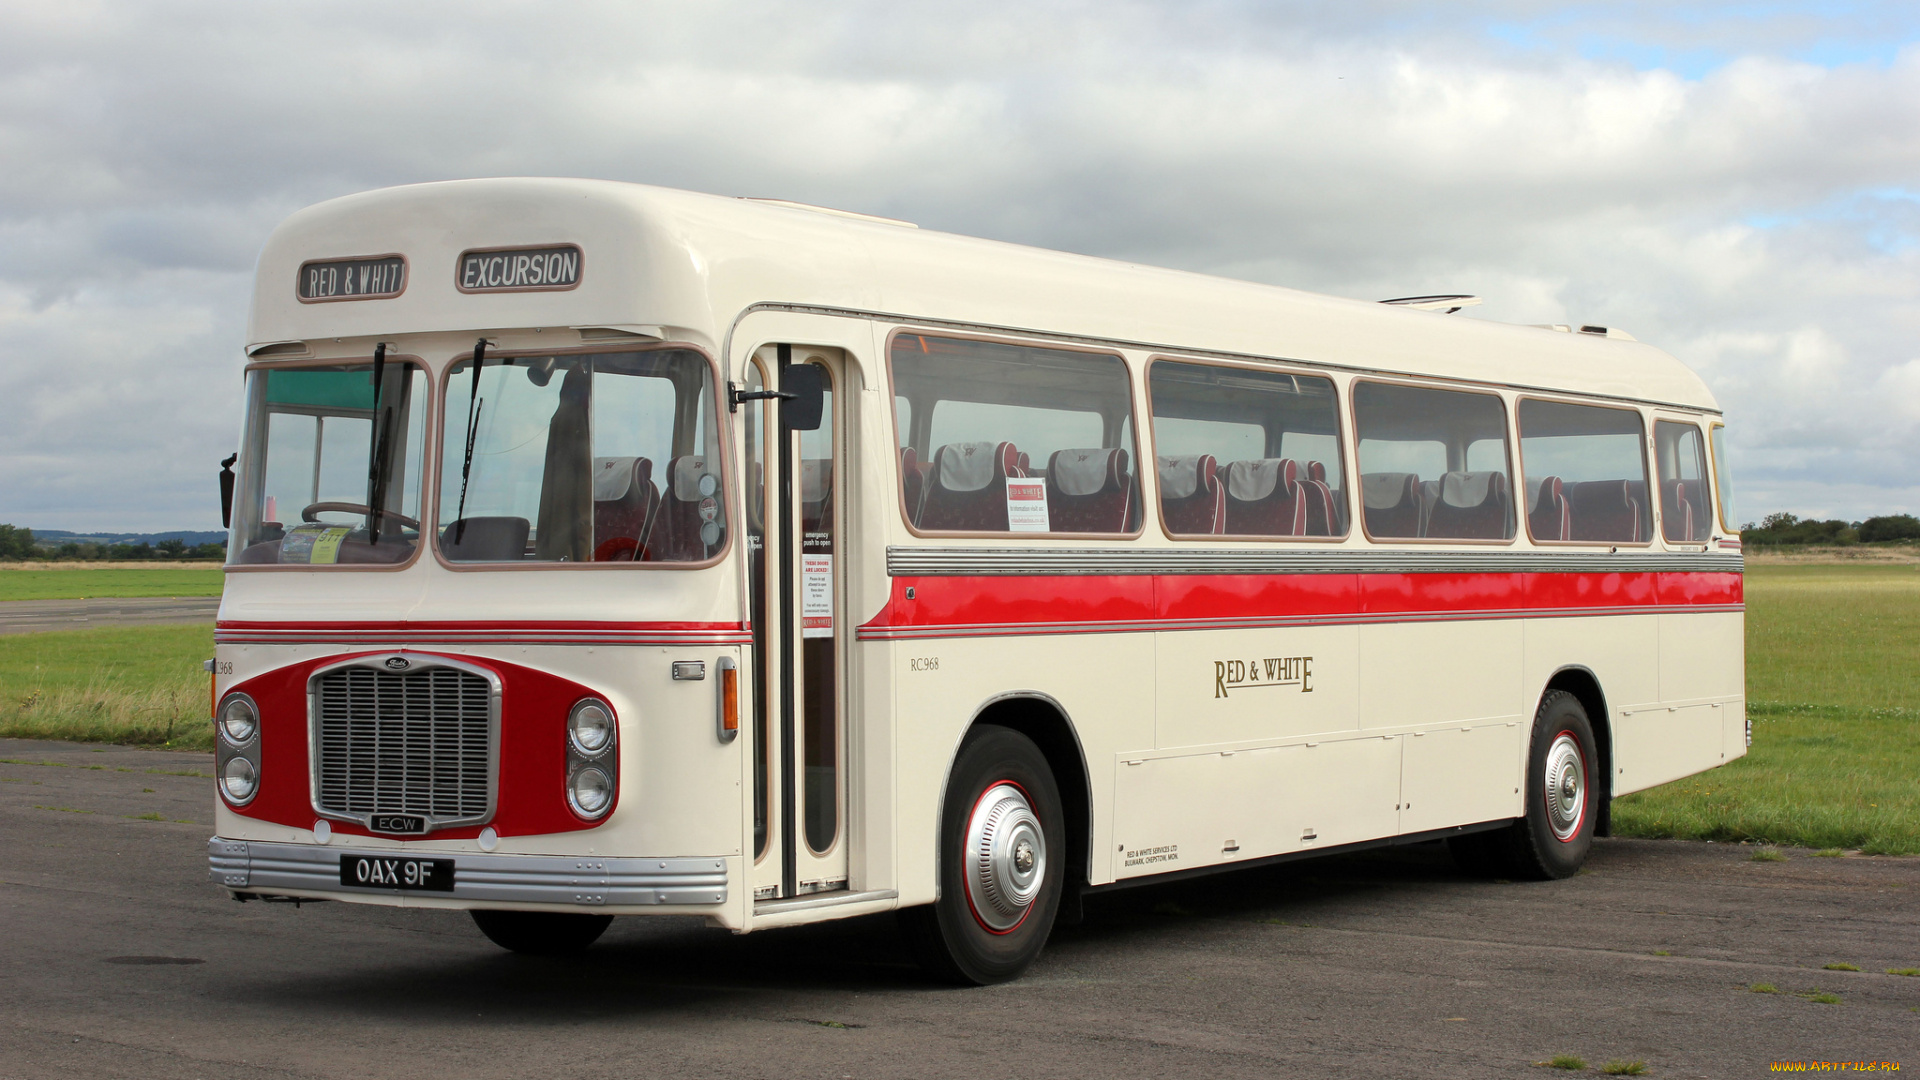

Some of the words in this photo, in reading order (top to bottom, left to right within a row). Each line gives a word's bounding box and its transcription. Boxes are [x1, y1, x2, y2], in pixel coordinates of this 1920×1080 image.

[309, 268, 337, 298] RED
[345, 266, 353, 295] &
[463, 252, 577, 288] EXCURSION
[805, 532, 829, 540] emergency
[1214, 659, 1245, 699] RED
[1250, 660, 1259, 681] &
[1263, 656, 1313, 693] WHITE
[379, 817, 416, 830] ECW
[356, 858, 398, 884] OAX
[404, 861, 434, 886] 9F
